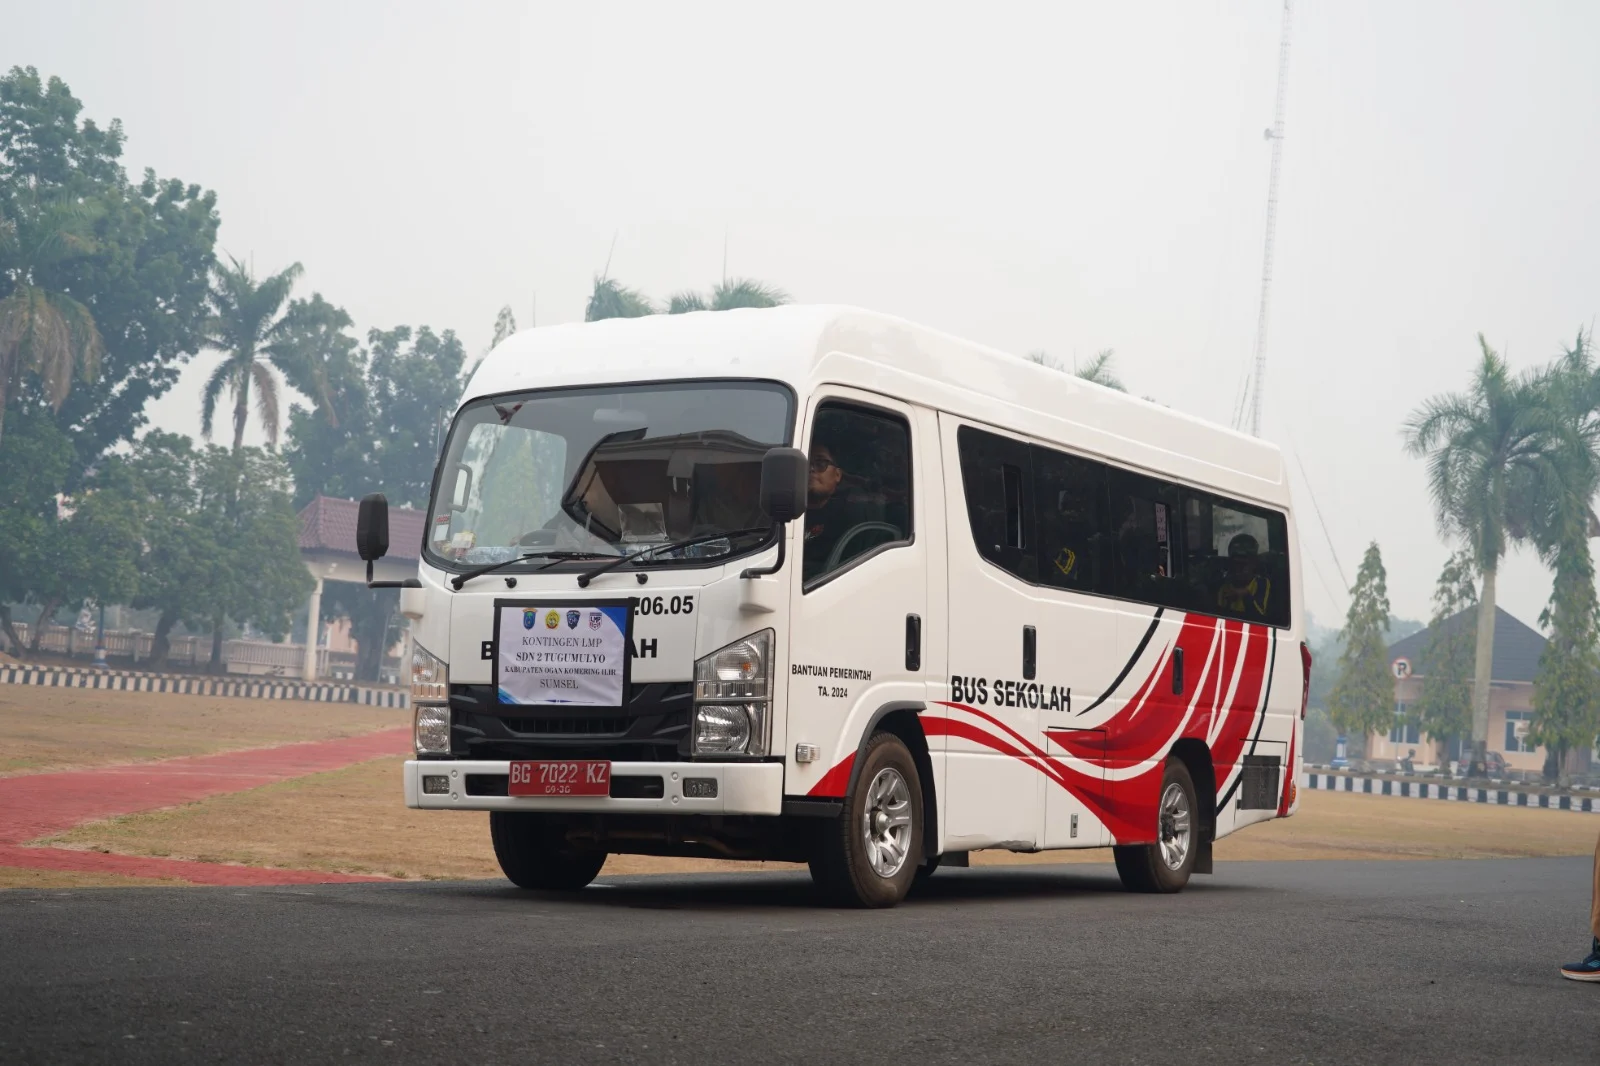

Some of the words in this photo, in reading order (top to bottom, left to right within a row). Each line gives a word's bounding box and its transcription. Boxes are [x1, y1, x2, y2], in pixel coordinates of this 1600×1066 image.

[522, 636, 581, 648] KONTINGEN
[581, 638, 603, 648] LMP
[516, 652, 536, 662] SDN
[537, 653, 543, 662] 2
[544, 652, 606, 664] TUGUMULYO
[504, 666, 543, 675] KABUPATEN
[544, 667, 563, 675] OGAN
[564, 667, 600, 676] KOMERING
[601, 668, 617, 676] ILIR
[791, 664, 828, 678] BANTUAN
[829, 667, 872, 681] PEMERINTAH
[540, 679, 579, 689] SUMSEL
[818, 686, 830, 697] TA.
[831, 686, 848, 699] 2024
[951, 675, 988, 706] BUS
[993, 679, 1071, 713] SEKOLAH
[511, 763, 531, 784] BG
[540, 763, 578, 784] 7022
[586, 763, 607, 784] KZ
